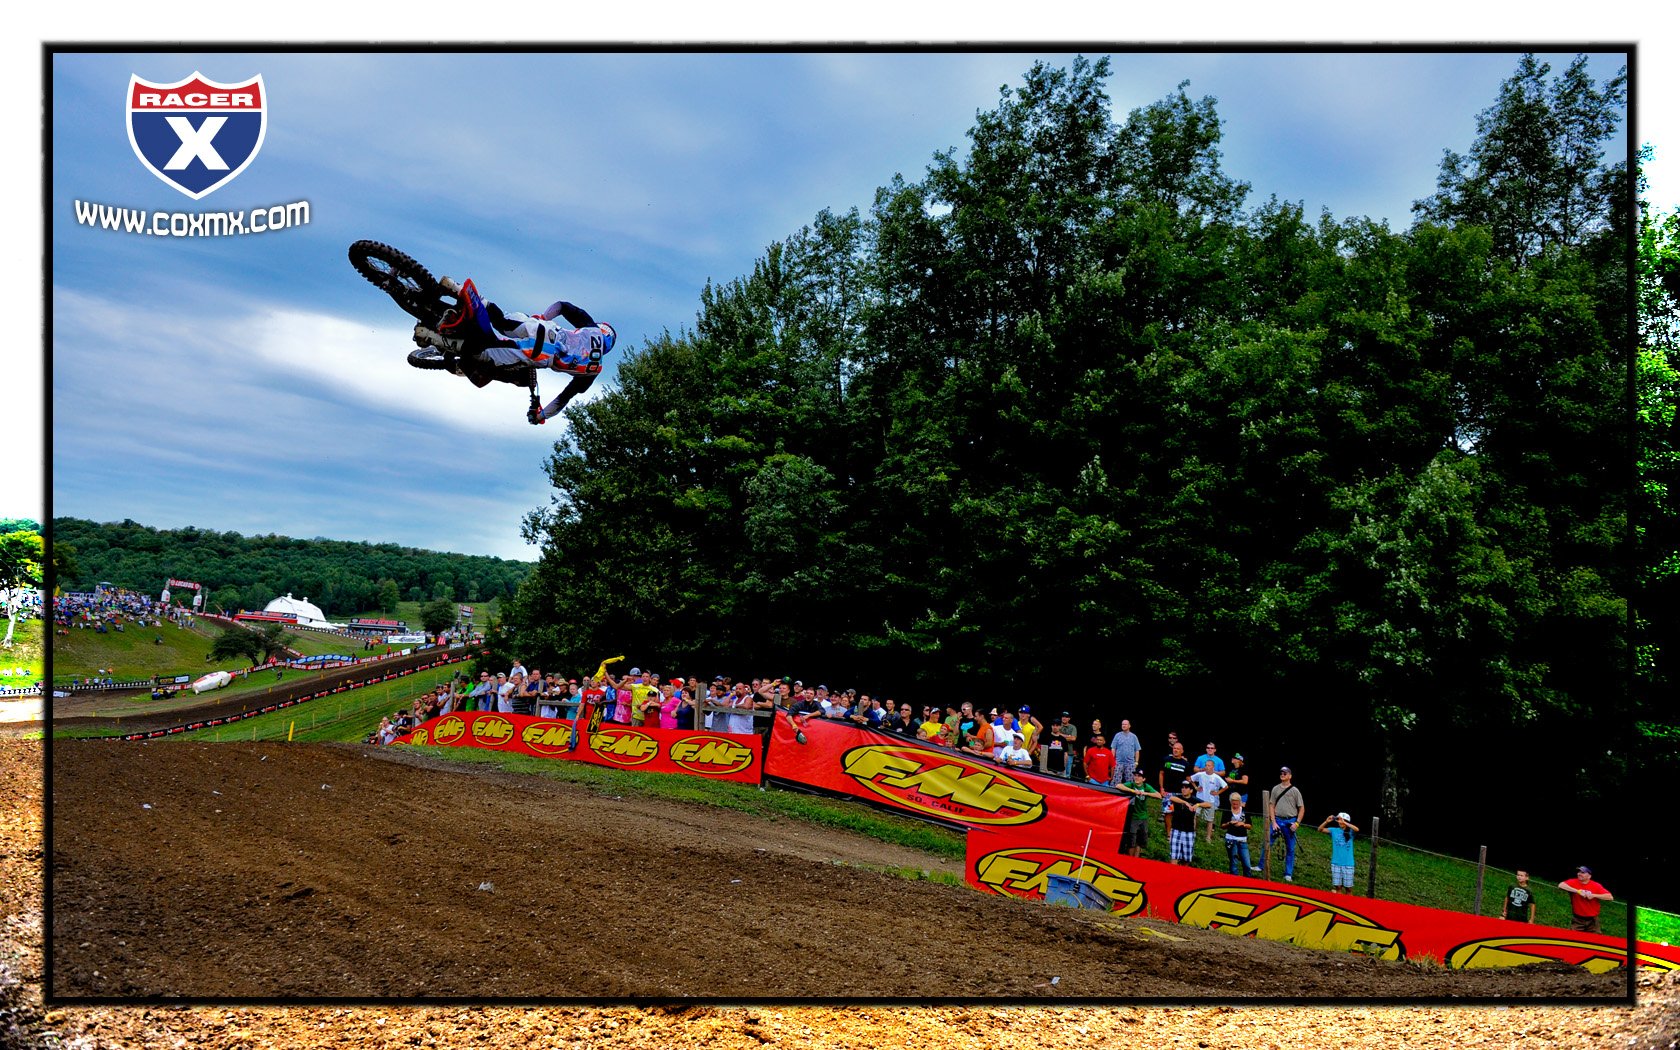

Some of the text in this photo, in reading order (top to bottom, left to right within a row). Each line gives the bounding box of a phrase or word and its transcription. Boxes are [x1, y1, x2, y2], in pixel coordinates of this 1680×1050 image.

[586, 335, 602, 373] 200
[434, 719, 465, 740] FMF
[472, 720, 514, 738] FMF
[590, 734, 658, 759] FMF
[670, 741, 752, 766] FMF
[844, 749, 1045, 813] FMF
